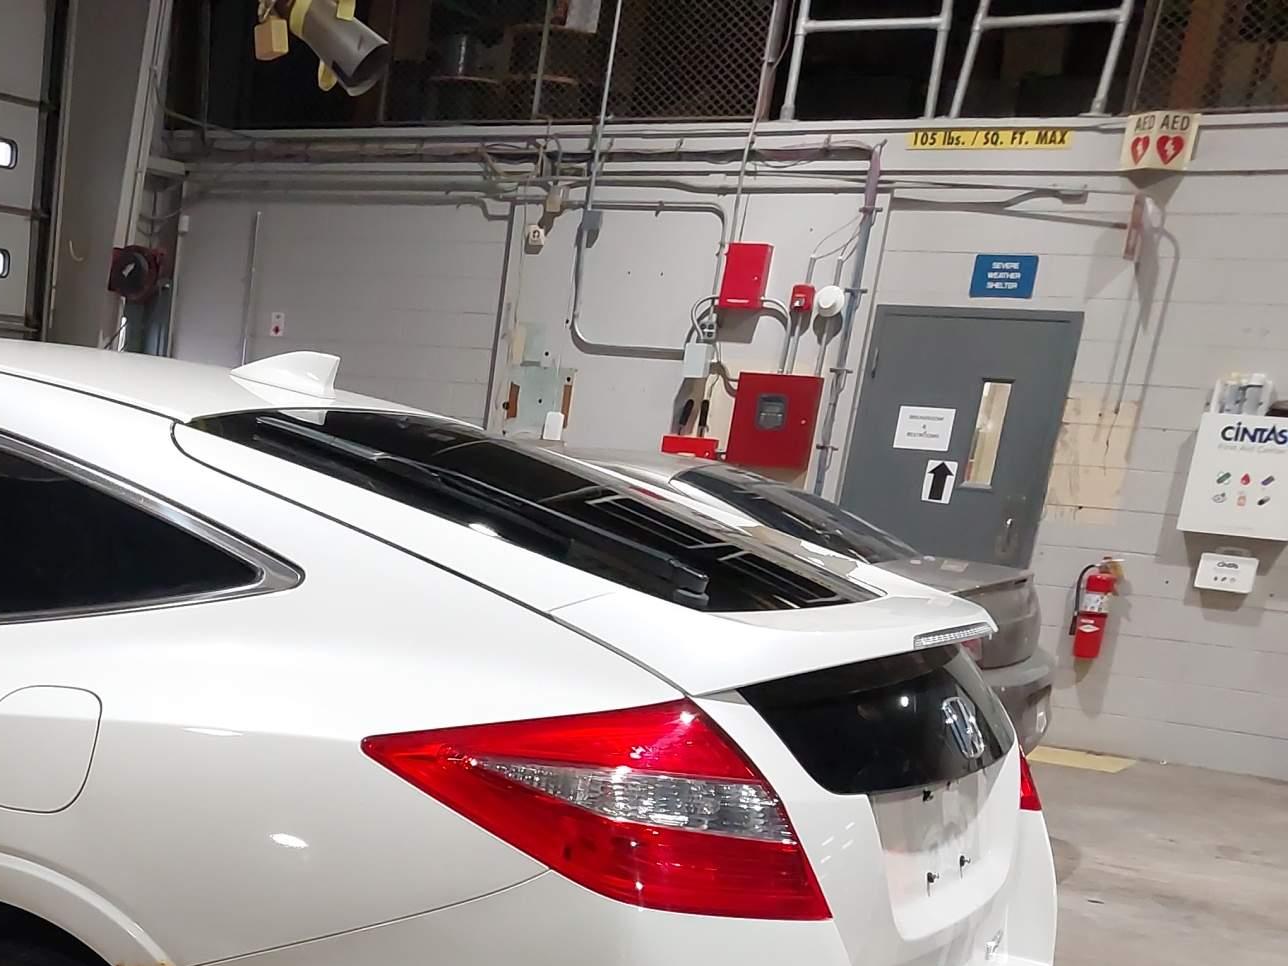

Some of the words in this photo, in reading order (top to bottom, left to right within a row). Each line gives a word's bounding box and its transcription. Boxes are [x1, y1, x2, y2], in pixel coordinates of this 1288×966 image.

[1134, 114, 1156, 132] AED
[1159, 114, 1191, 131] AED
[913, 131, 938, 146] 105
[942, 130, 966, 146] lbs.
[970, 129, 980, 146] /
[983, 130, 1004, 146] SQ.
[1010, 130, 1029, 145] FT.
[1035, 129, 1069, 145] MAX
[992, 261, 1021, 270] SEVERE
[987, 271, 1021, 280] WEATHER
[985, 281, 1018, 290] SHELTER
